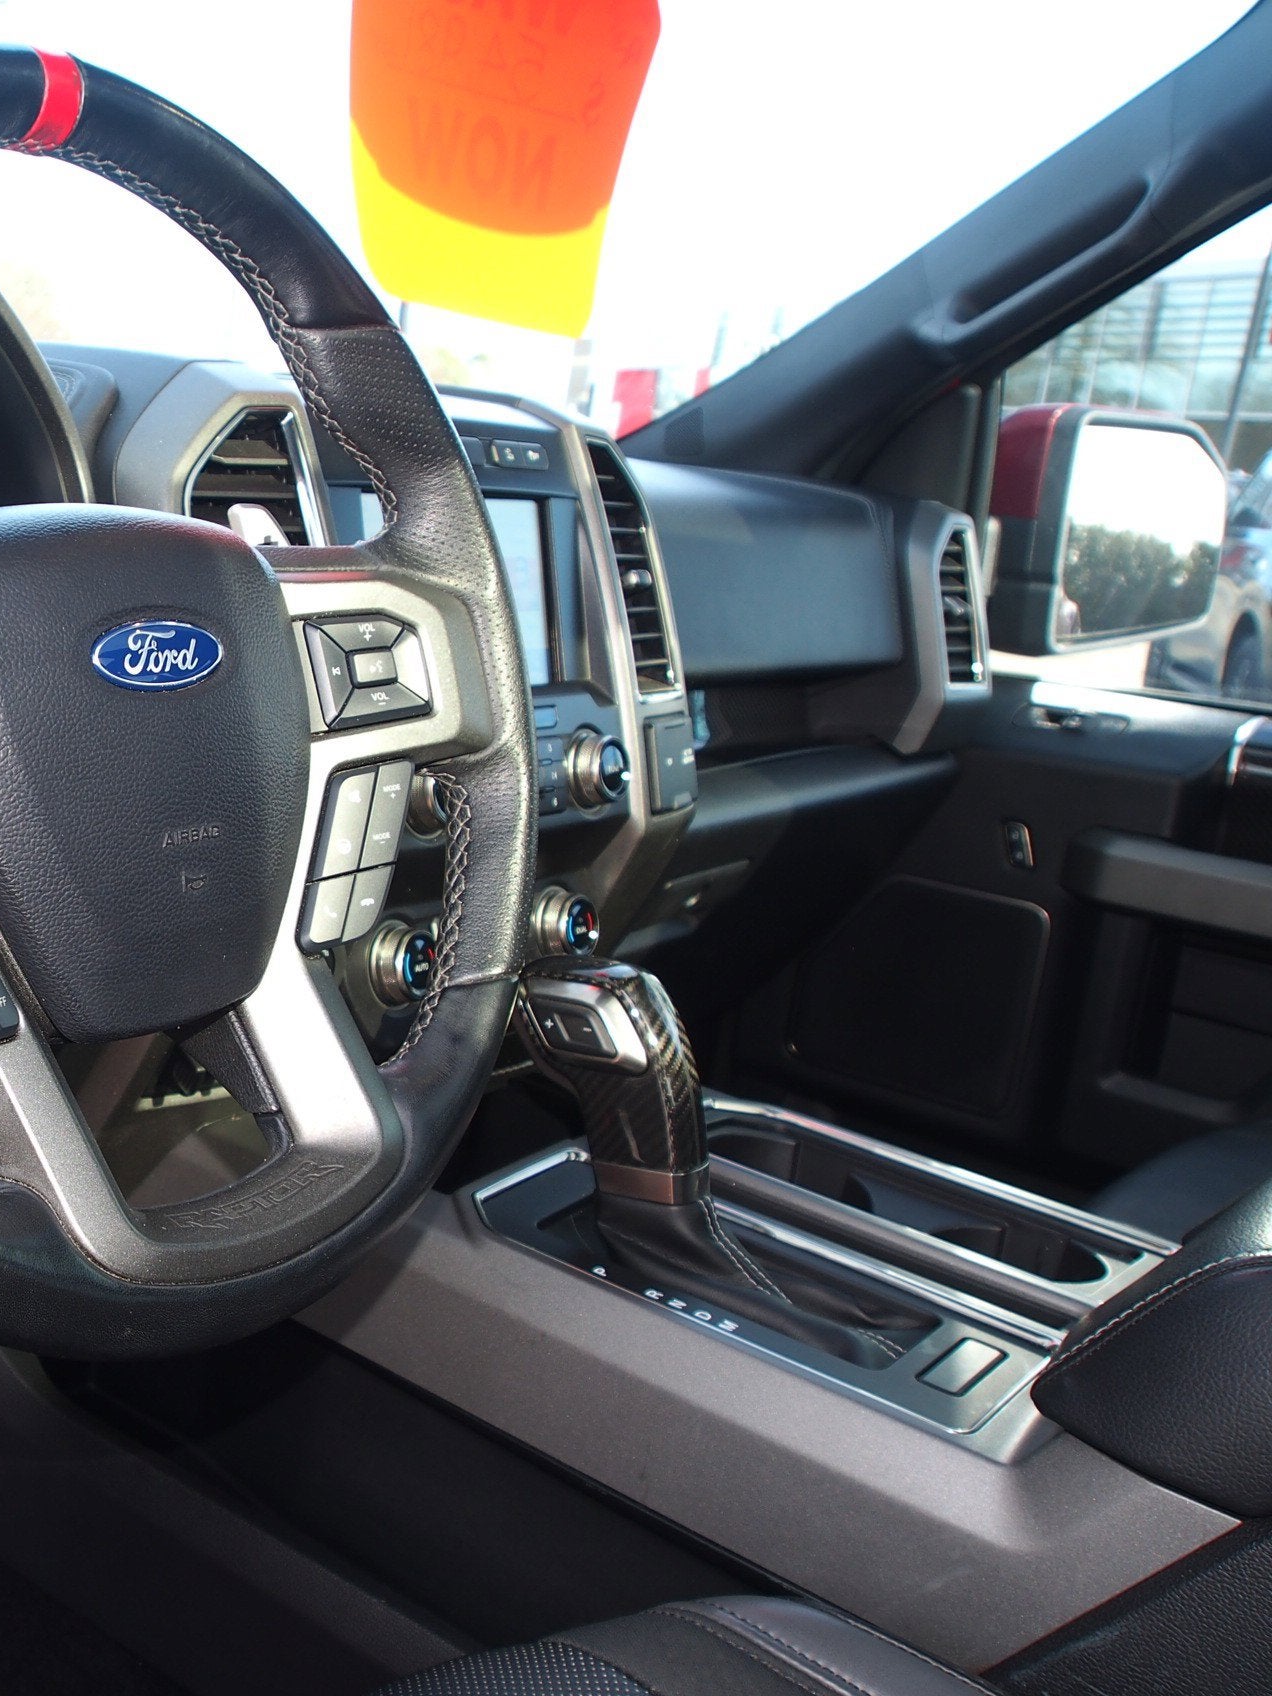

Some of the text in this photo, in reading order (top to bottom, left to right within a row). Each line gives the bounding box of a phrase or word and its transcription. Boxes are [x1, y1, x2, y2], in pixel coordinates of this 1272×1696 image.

[357, 623, 377, 633] VOL
[123, 628, 199, 676] Ford
[370, 691, 390, 701] VOL
[382, 782, 402, 793] MODE
[162, 824, 222, 849] AIRBAG
[371, 831, 392, 842] MODE
[593, 1266, 606, 1276] P
[645, 1289, 663, 1299] R
[694, 1311, 711, 1321] D
